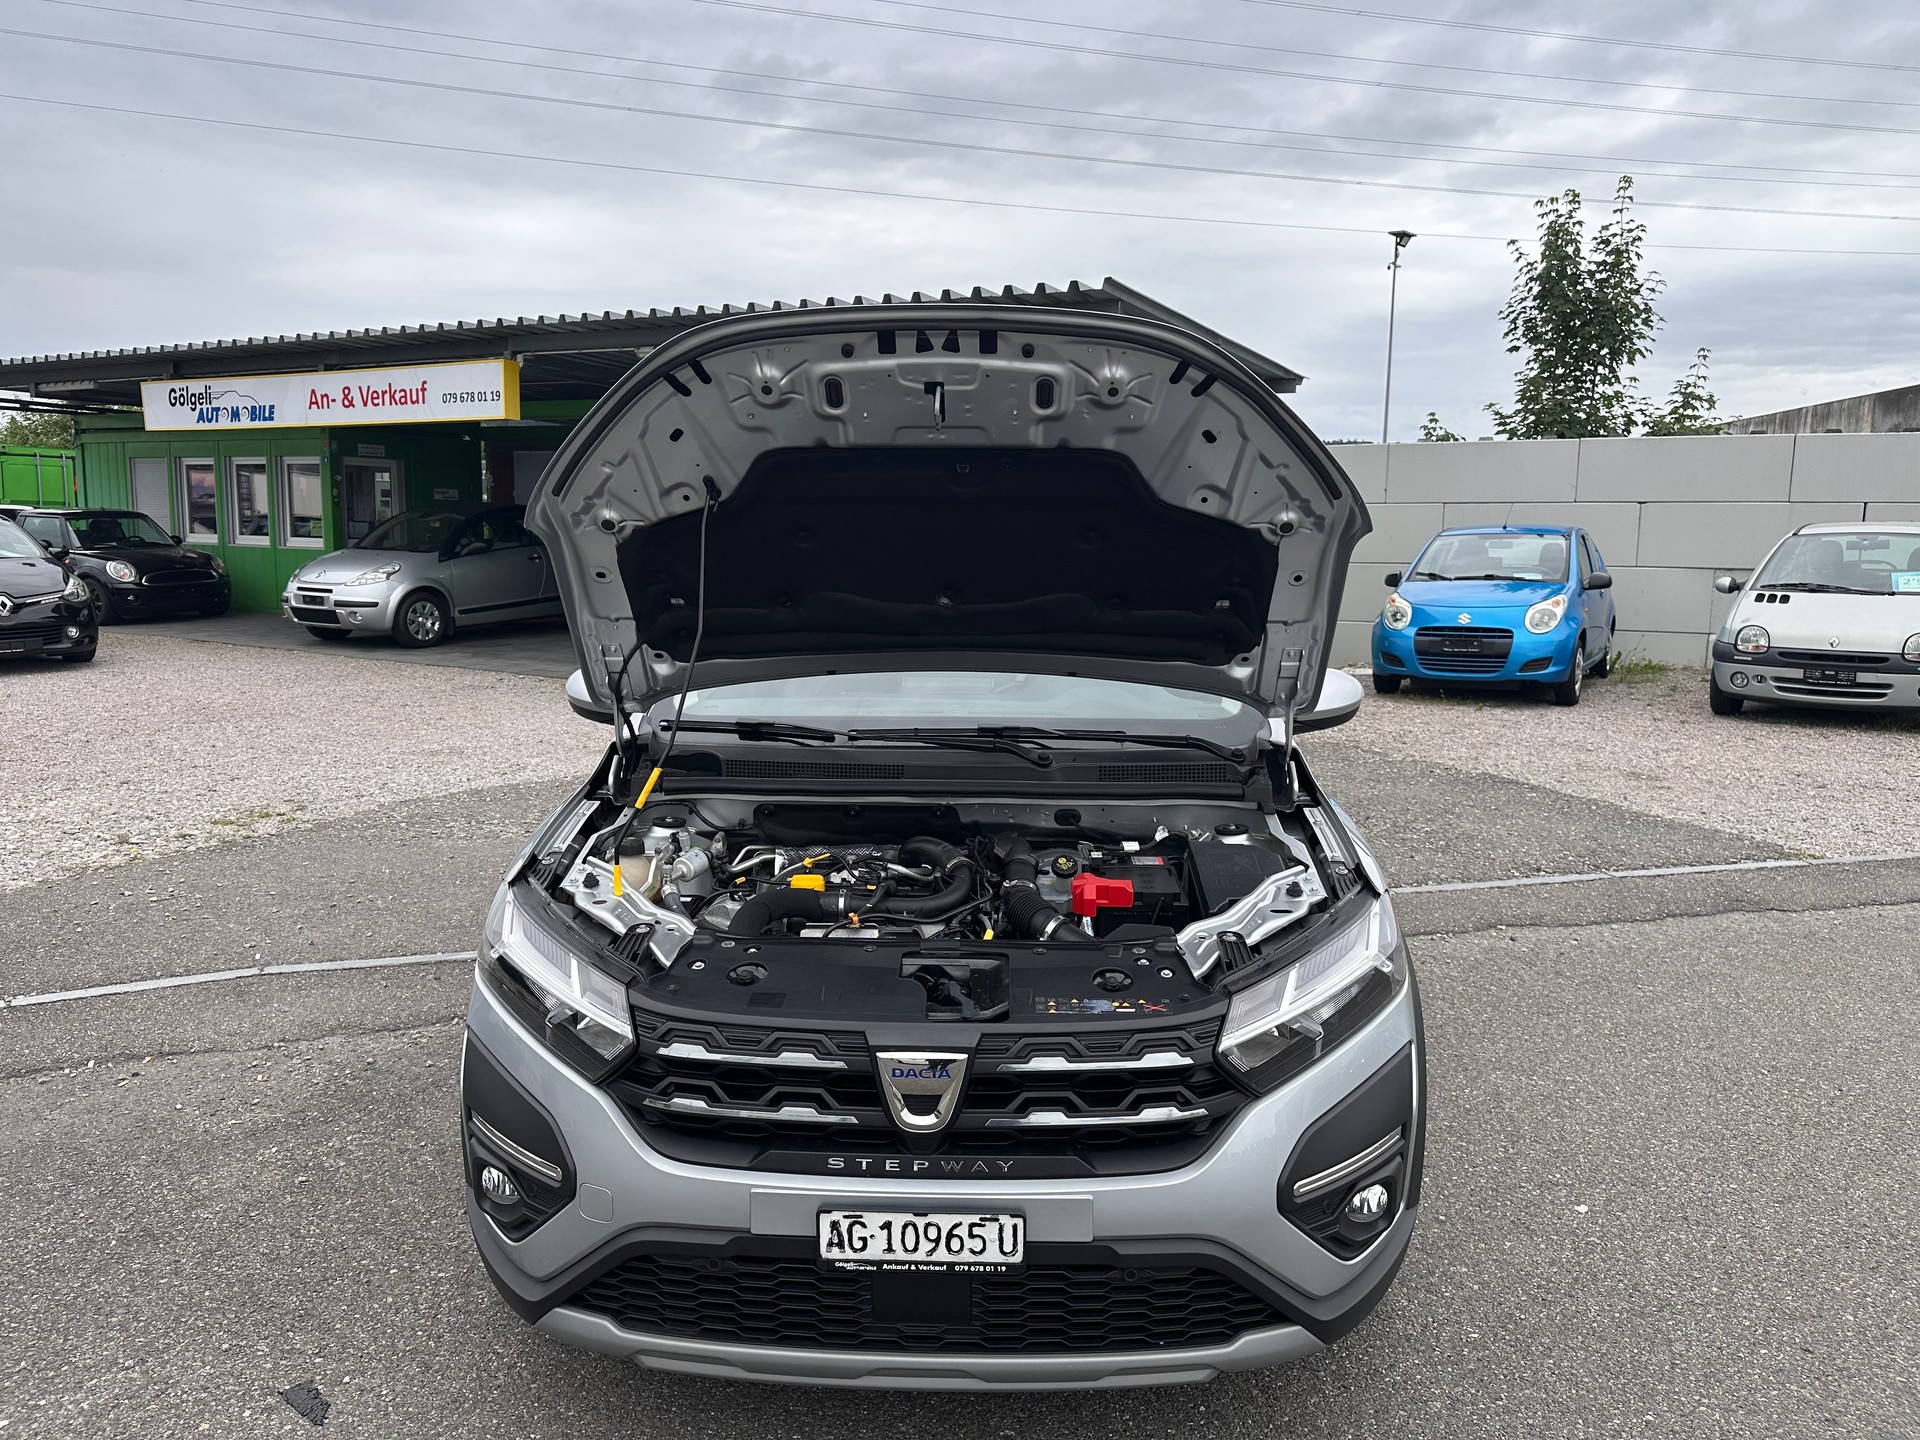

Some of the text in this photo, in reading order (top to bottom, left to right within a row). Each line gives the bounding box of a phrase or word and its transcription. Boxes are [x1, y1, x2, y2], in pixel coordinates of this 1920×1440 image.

[168, 385, 212, 412] Gölgeli
[308, 380, 501, 410] An- & Verkauf 079 678 01 19
[891, 1068, 952, 1079] DACIA
[827, 1157, 1014, 1173] STEPWAY
